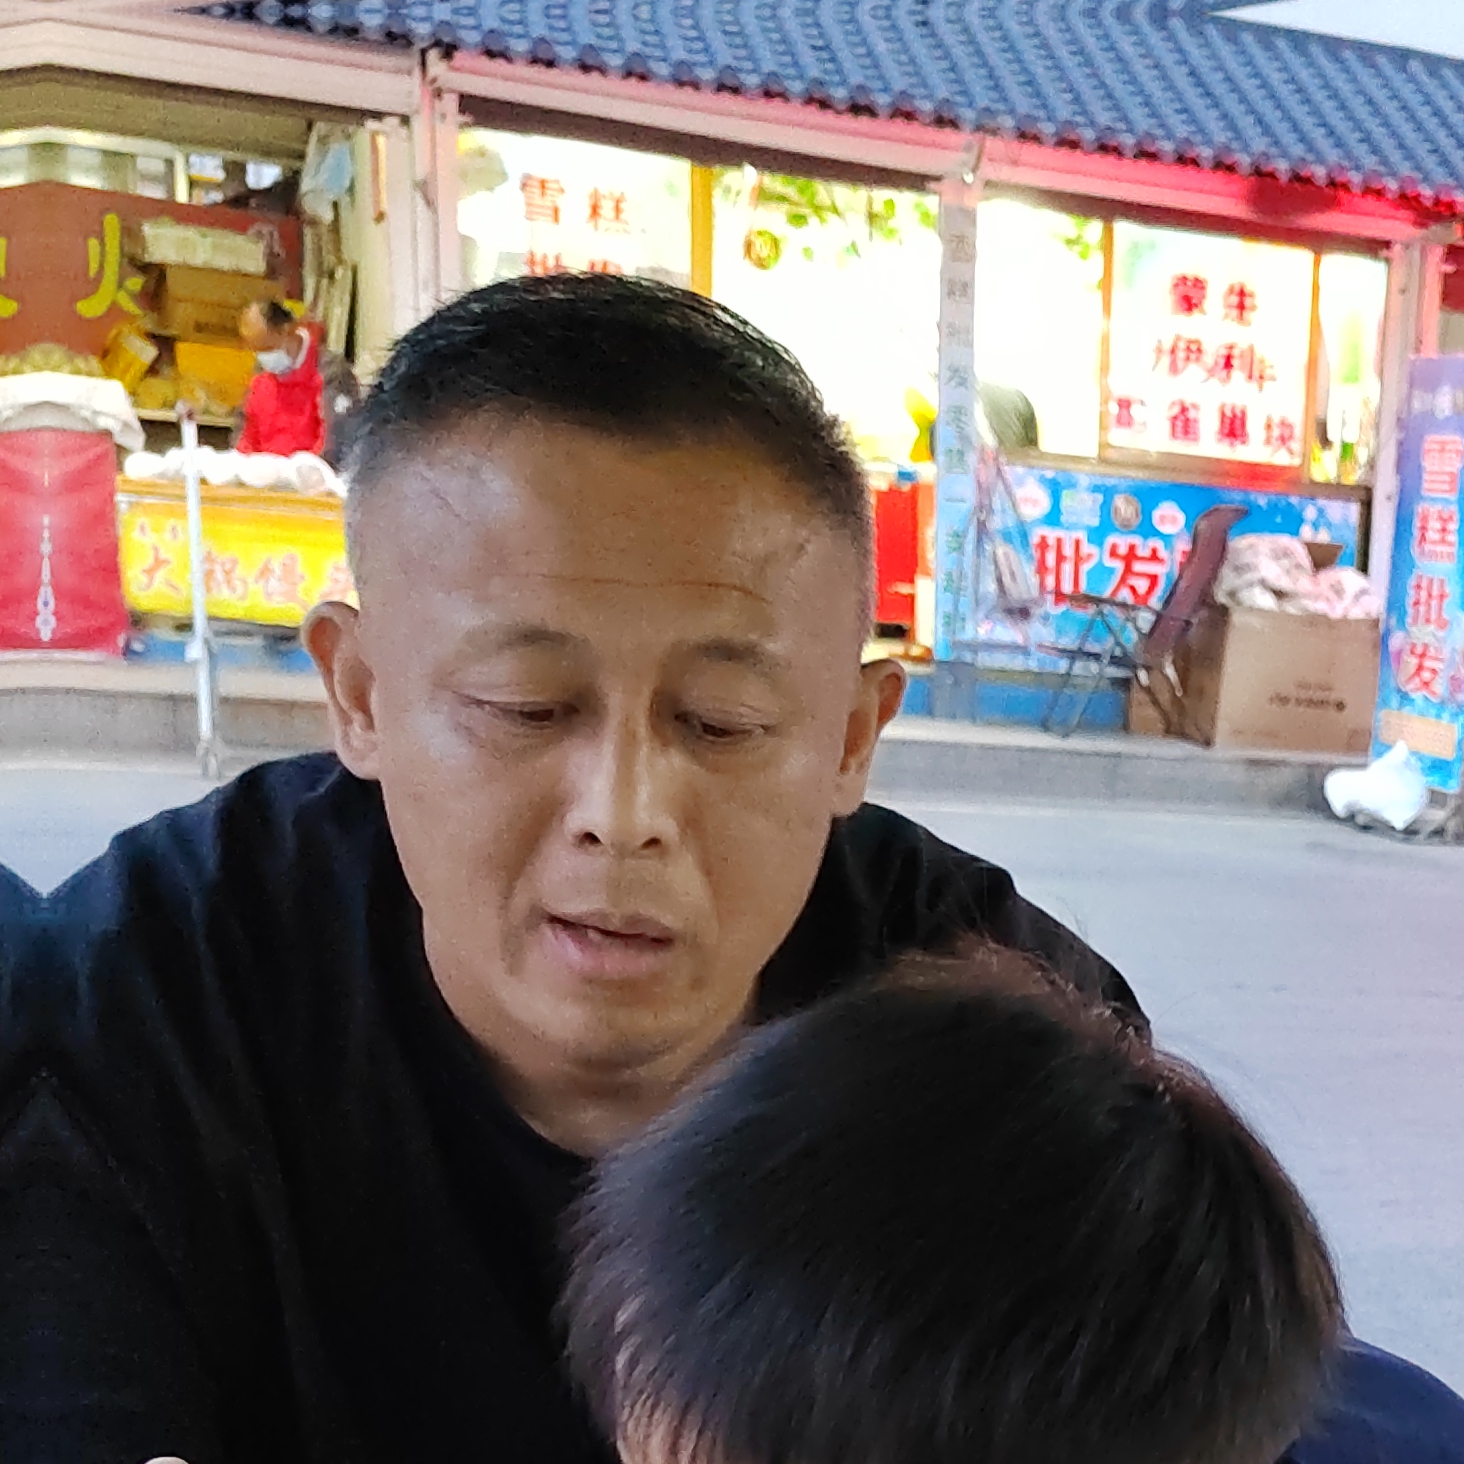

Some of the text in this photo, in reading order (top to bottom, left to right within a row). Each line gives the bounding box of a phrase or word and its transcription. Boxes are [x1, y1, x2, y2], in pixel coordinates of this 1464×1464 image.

[519, 172, 631, 235] 雪糕
[1034, 533, 1190, 607] 批发
[1403, 435, 1464, 698] 雪糕批发
